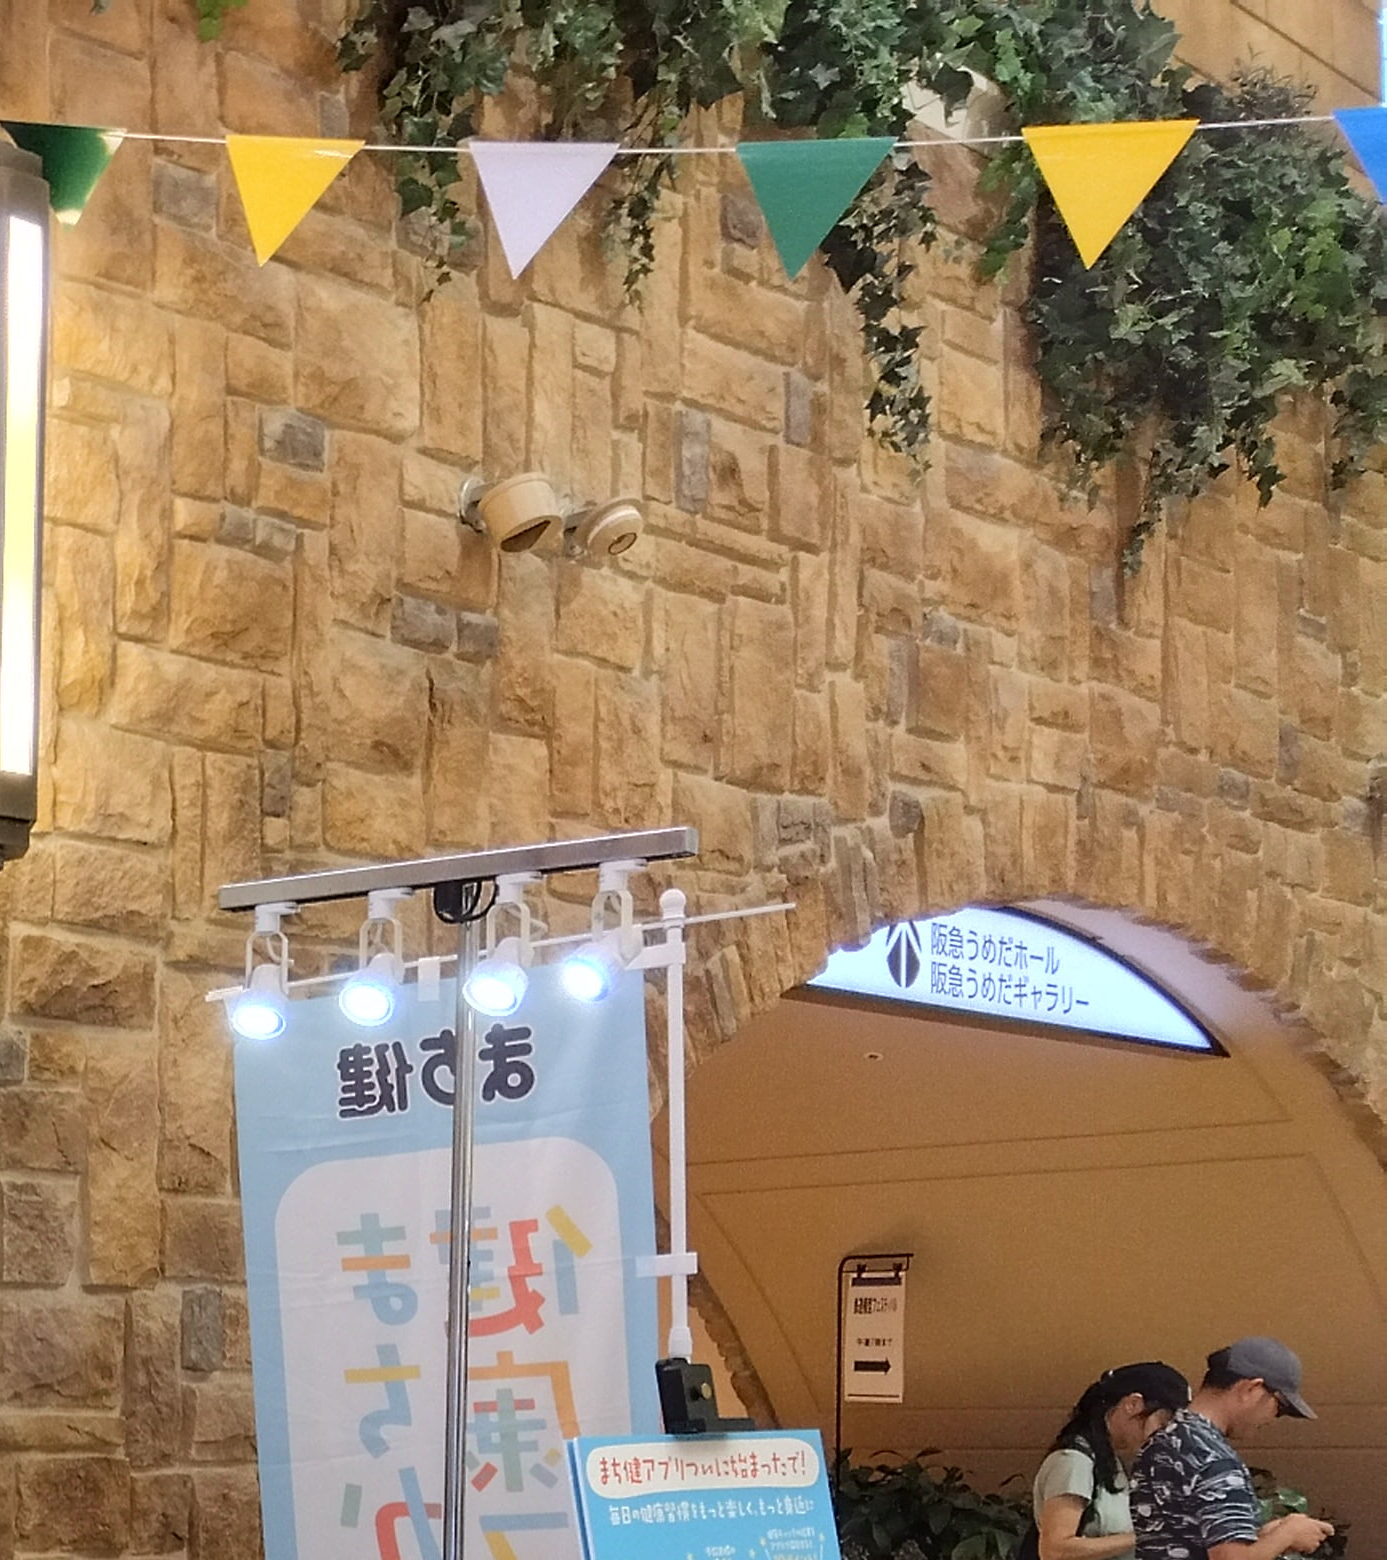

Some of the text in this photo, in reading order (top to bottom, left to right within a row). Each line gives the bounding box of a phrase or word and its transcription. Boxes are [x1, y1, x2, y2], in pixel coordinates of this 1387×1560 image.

[931, 922, 1060, 975] 阪急うめだホール
[931, 962, 1090, 1014] 阪急うめだギャラリー
